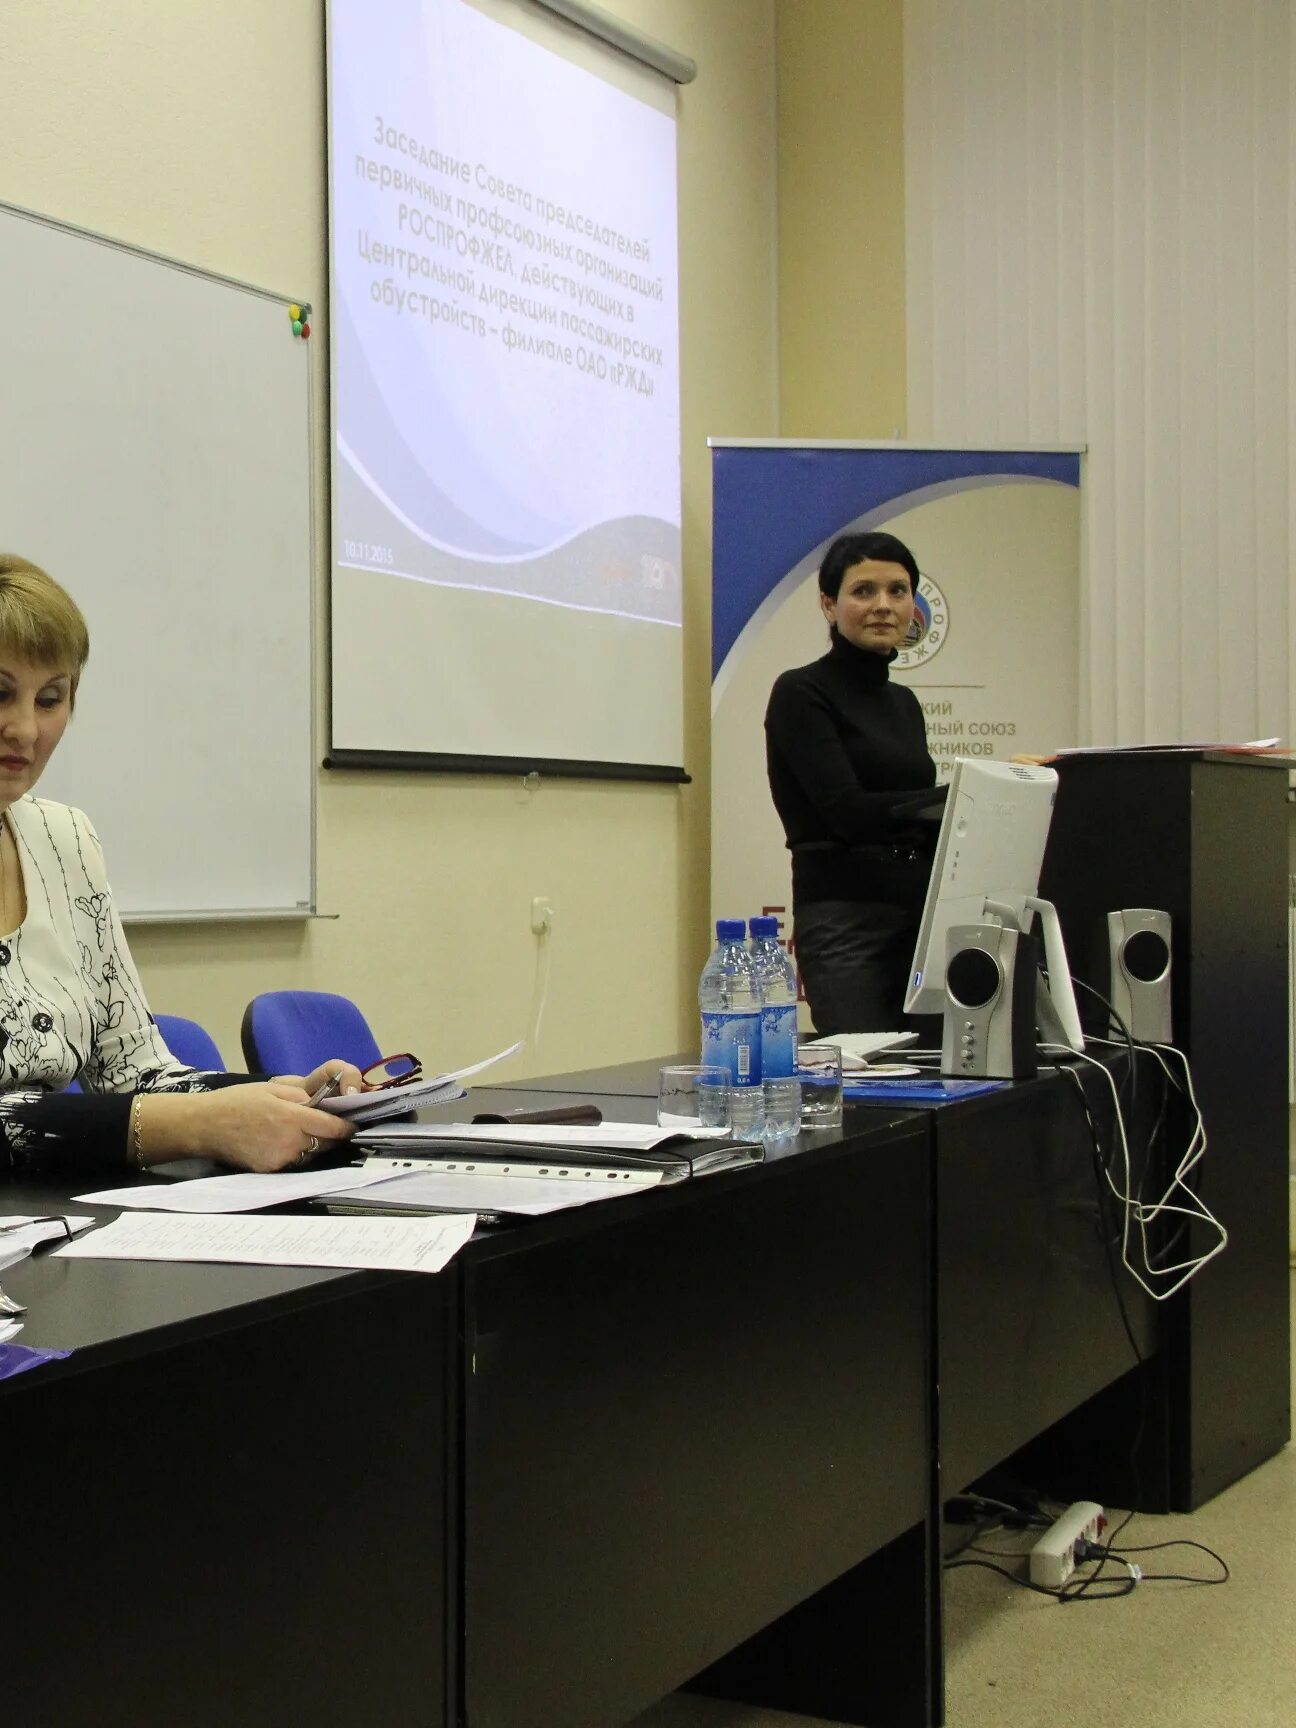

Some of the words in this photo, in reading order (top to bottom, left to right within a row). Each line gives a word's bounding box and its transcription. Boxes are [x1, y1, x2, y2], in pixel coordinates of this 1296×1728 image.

[355, 154, 453, 210] первичных
[456, 196, 573, 263] профсоюзных
[576, 249, 663, 302] организаций
[374, 116, 471, 183] Заседание
[474, 163, 533, 204] Совета
[536, 194, 651, 264] председателей
[357, 229, 475, 298] Центральной
[477, 283, 558, 326] дирекции
[561, 310, 663, 367] пассажирских
[370, 277, 487, 338] обустройств
[501, 320, 573, 367] филиале
[575, 344, 606, 381] ОАО
[521, 262, 624, 317] действующих
[626, 303, 635, 323] в
[968, 722, 1017, 737] СОЮЗ
